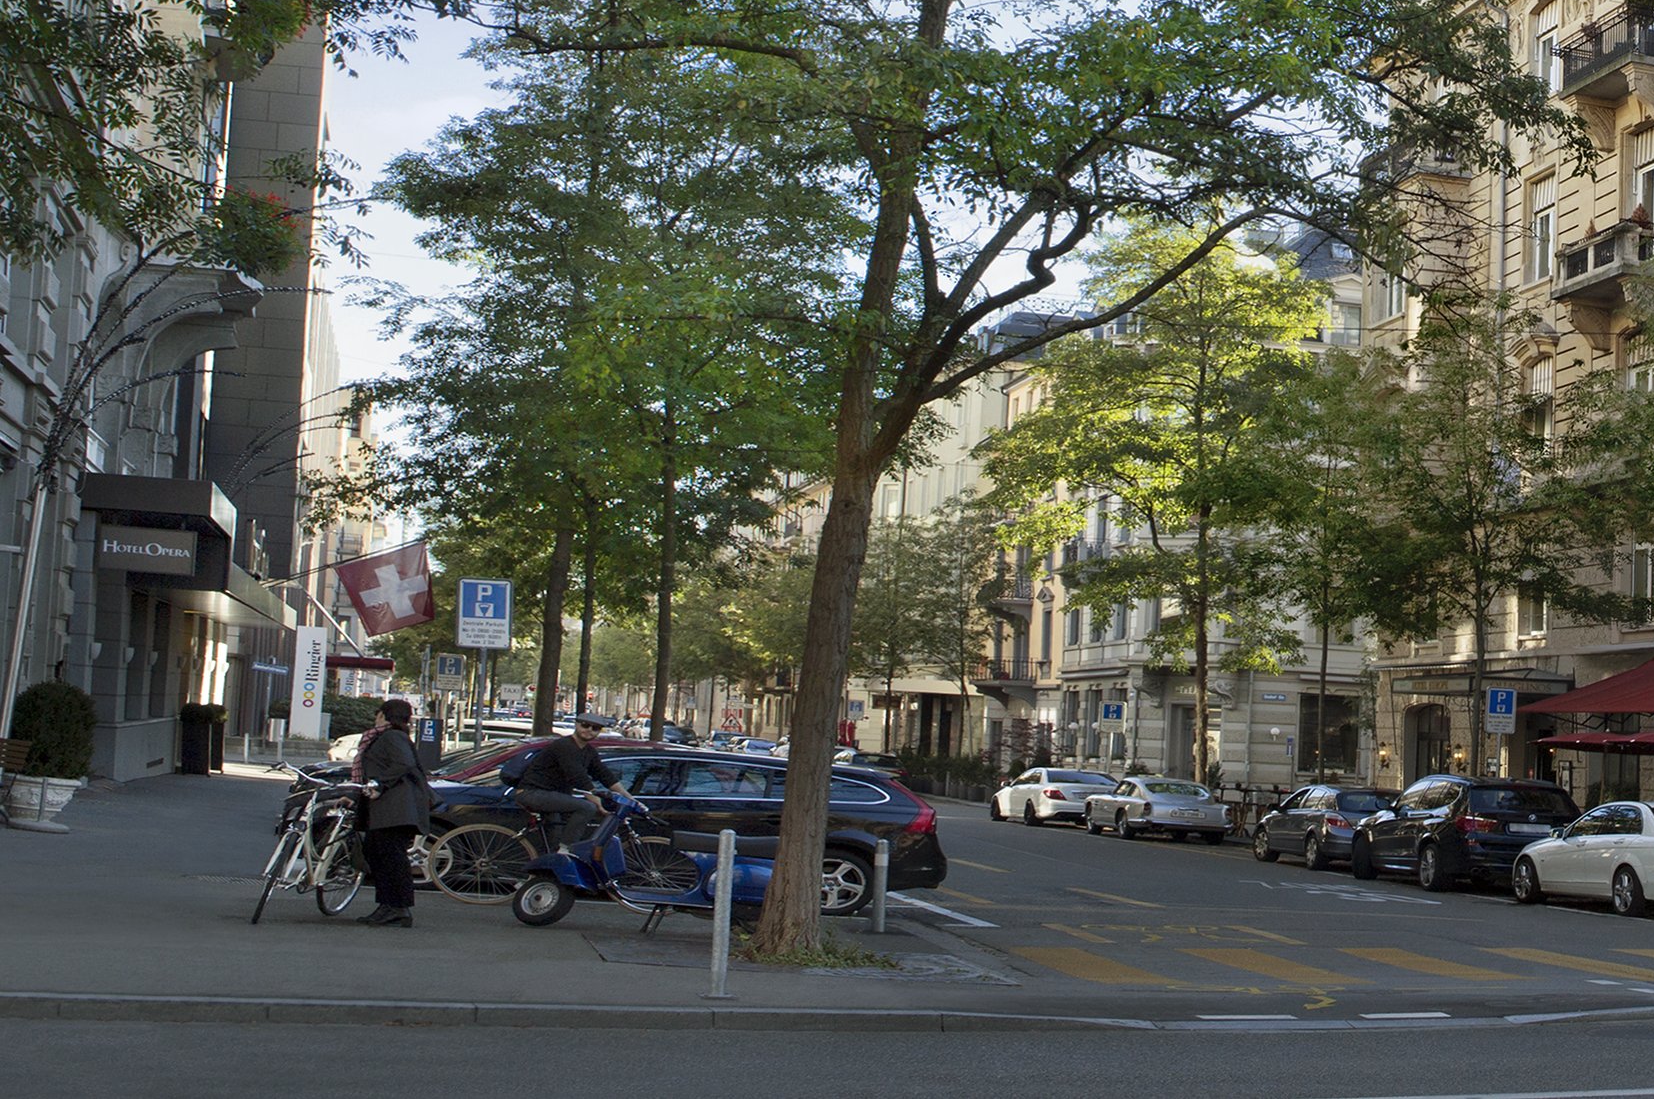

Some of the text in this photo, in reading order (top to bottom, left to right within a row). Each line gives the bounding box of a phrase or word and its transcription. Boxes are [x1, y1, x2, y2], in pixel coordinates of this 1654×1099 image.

[477, 584, 493, 601] P
[305, 640, 323, 681] Ringier
[1498, 692, 1506, 703] P
